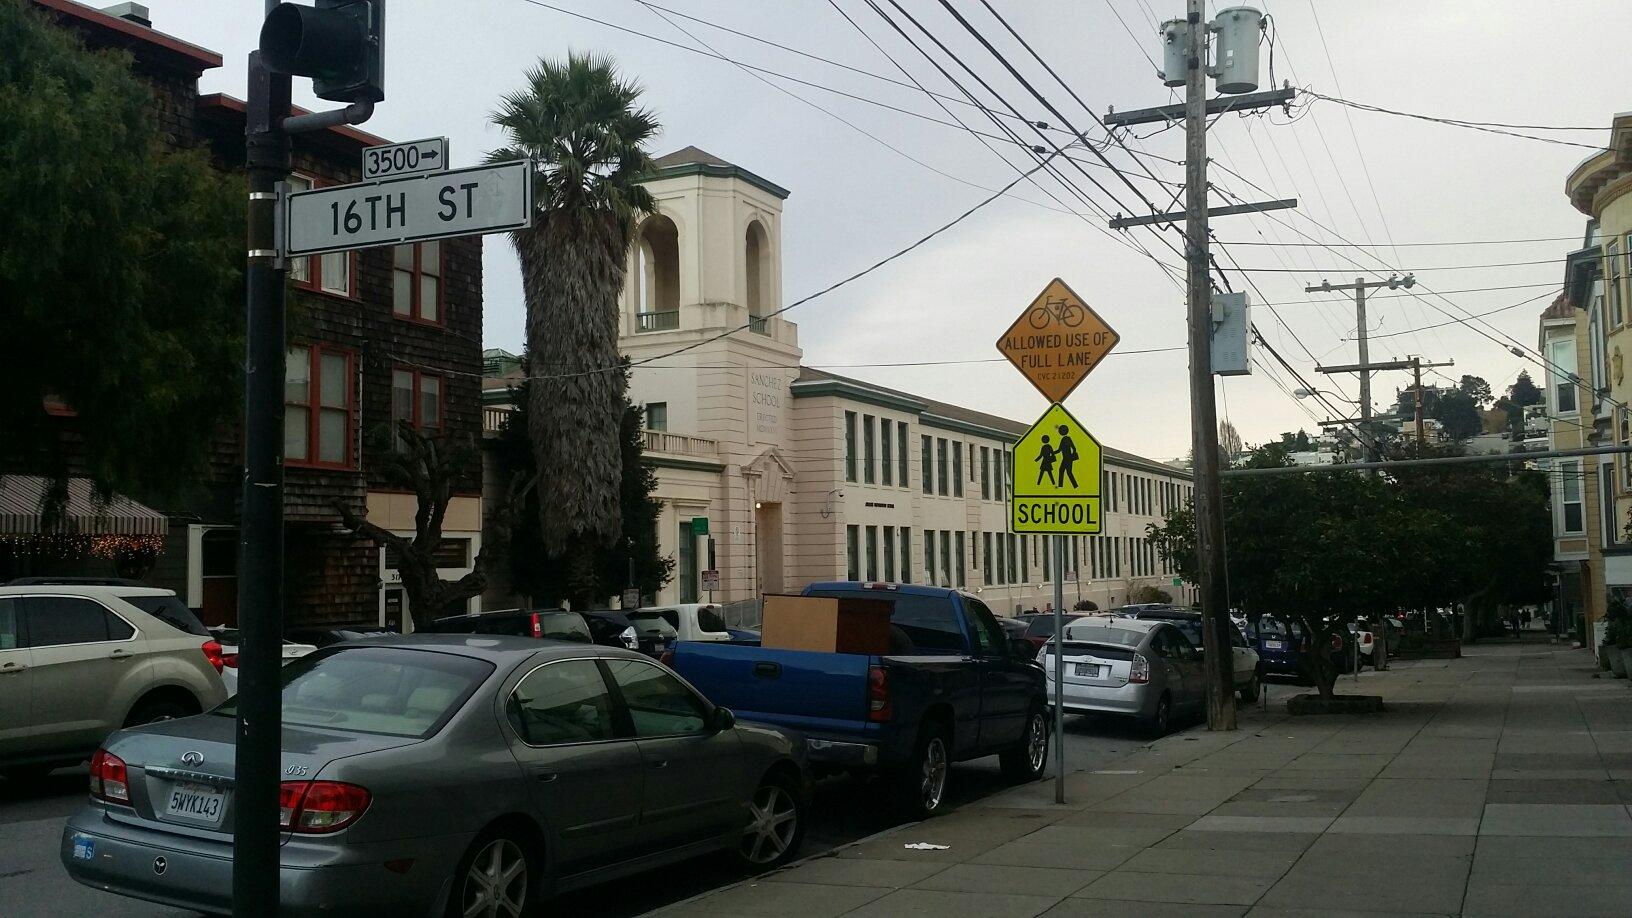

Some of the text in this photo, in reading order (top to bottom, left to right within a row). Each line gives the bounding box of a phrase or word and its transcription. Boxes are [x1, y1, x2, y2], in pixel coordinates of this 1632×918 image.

[368, 145, 419, 174] 3500
[331, 182, 479, 235] 16TH ST
[1005, 332, 1109, 350] ALLOWED USE OF
[1021, 352, 1091, 368] FULL LANE
[752, 392, 780, 408] SCHOOL
[1018, 503, 1097, 524] SCHOOL
[171, 791, 219, 815] 5WYK143
